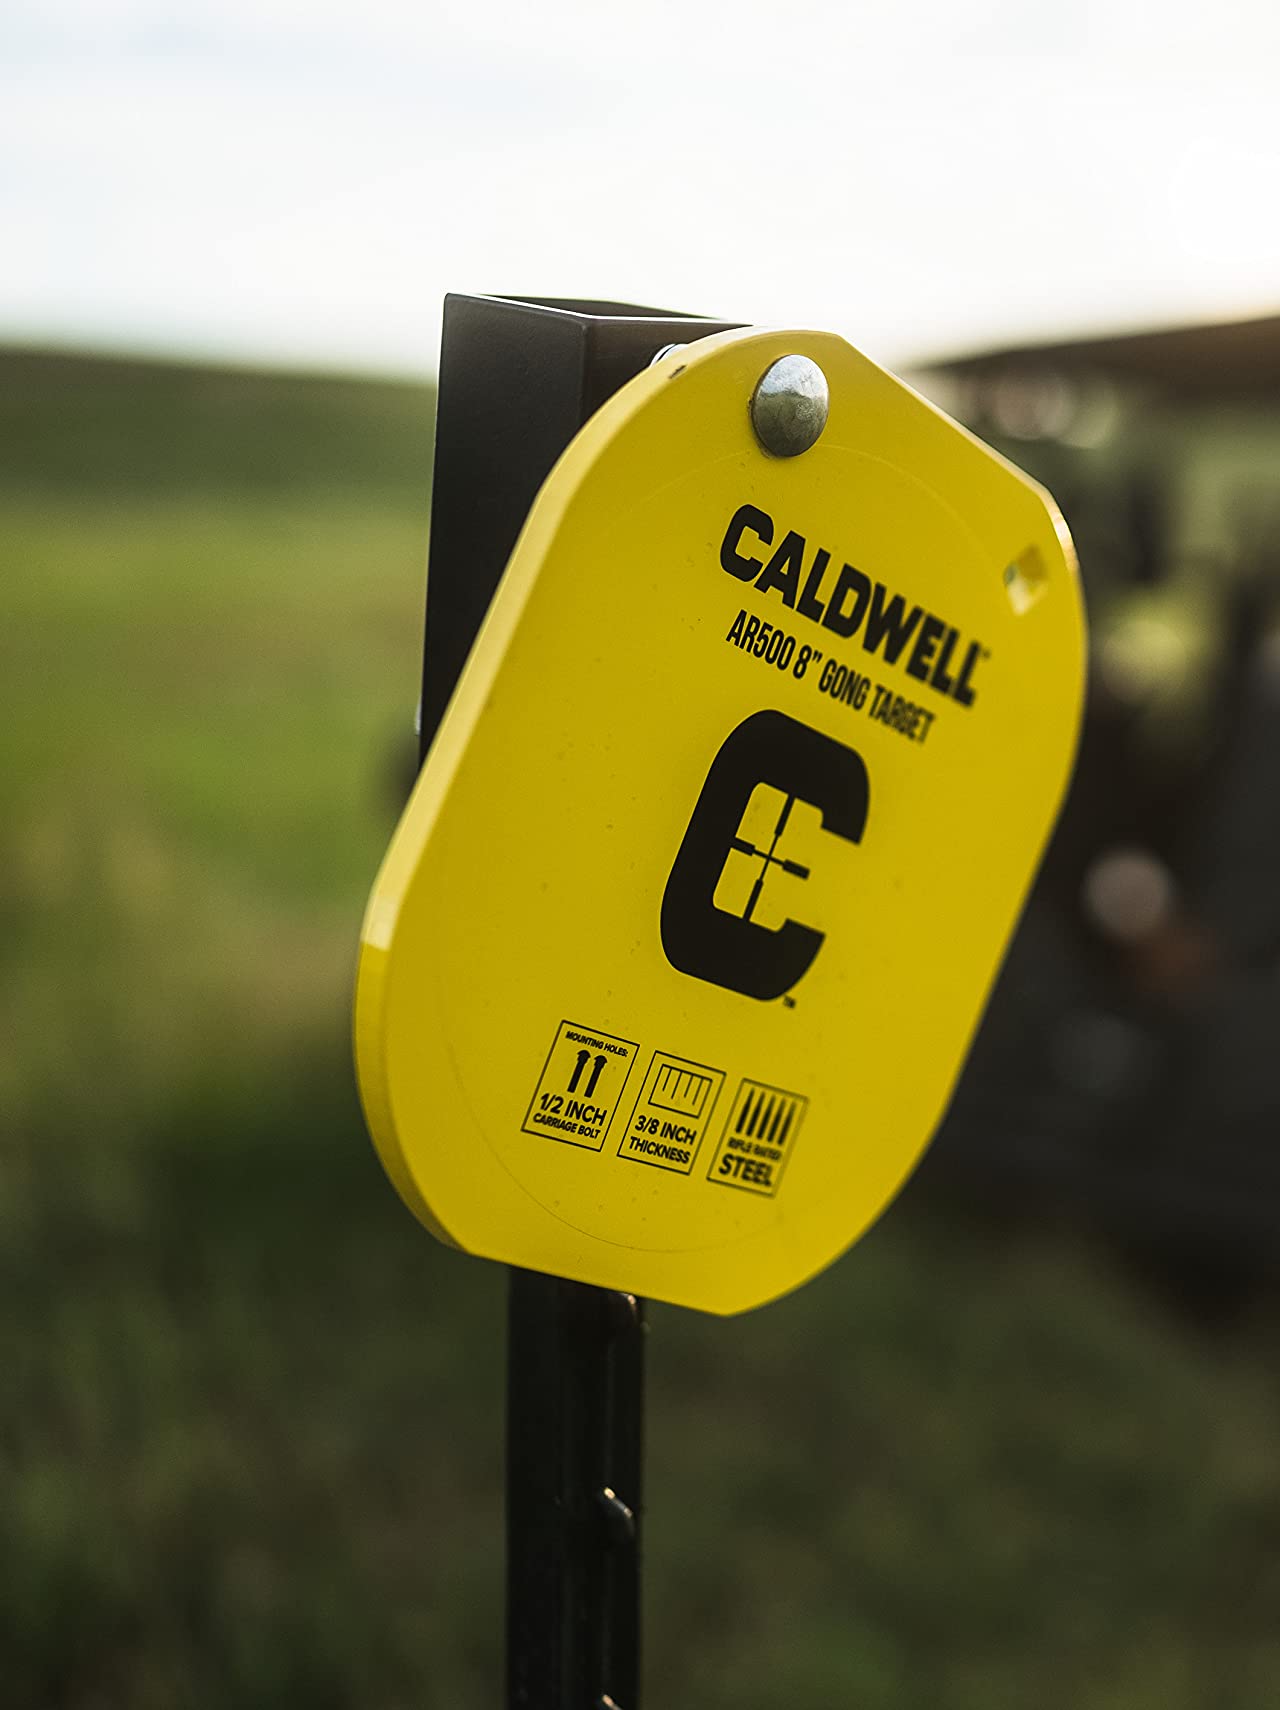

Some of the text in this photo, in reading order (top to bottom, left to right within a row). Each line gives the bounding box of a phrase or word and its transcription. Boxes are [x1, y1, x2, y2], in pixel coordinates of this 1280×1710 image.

[720, 504, 980, 707] CALDWELL
[726, 609, 796, 671] AR500
[818, 659, 871, 711] GONG
[869, 684, 935, 744] TARGET
[565, 1030, 604, 1050] MOUNTING
[540, 1093, 607, 1126] 1/2 INCH
[533, 1113, 601, 1140] CARRIAGE BOLT
[635, 1115, 697, 1145] 3/8 INCH
[629, 1136, 691, 1164] THICKNESS
[718, 1153, 773, 1186] STEEL
